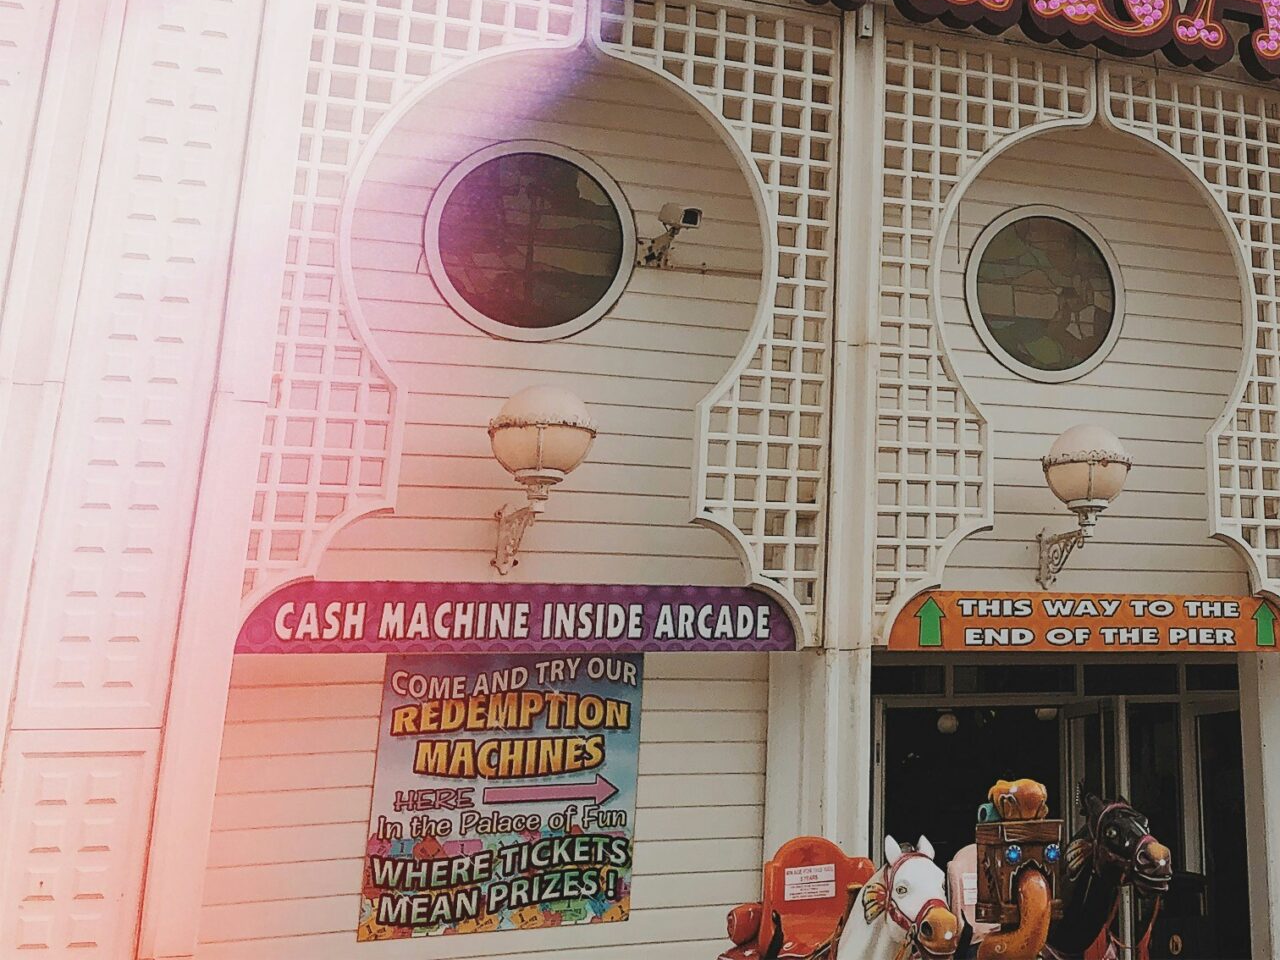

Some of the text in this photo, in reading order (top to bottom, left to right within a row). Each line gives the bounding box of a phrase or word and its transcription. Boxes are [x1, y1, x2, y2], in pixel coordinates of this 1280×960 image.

[275, 602, 770, 640] CASH MACHINE INSIDE ARCADE
[957, 599, 1240, 618] THIS WAY TO THE
[964, 627, 1236, 645] END OF THE PIER
[392, 657, 638, 700] COME AND TRY OUR
[392, 692, 630, 735] REDEMPTION
[414, 736, 605, 777] MACHINES
[394, 789, 475, 811] HERE
[377, 805, 627, 839] In the Palace of Fun
[371, 836, 628, 888] WHERE TICKETS
[378, 890, 479, 924] MEAN
